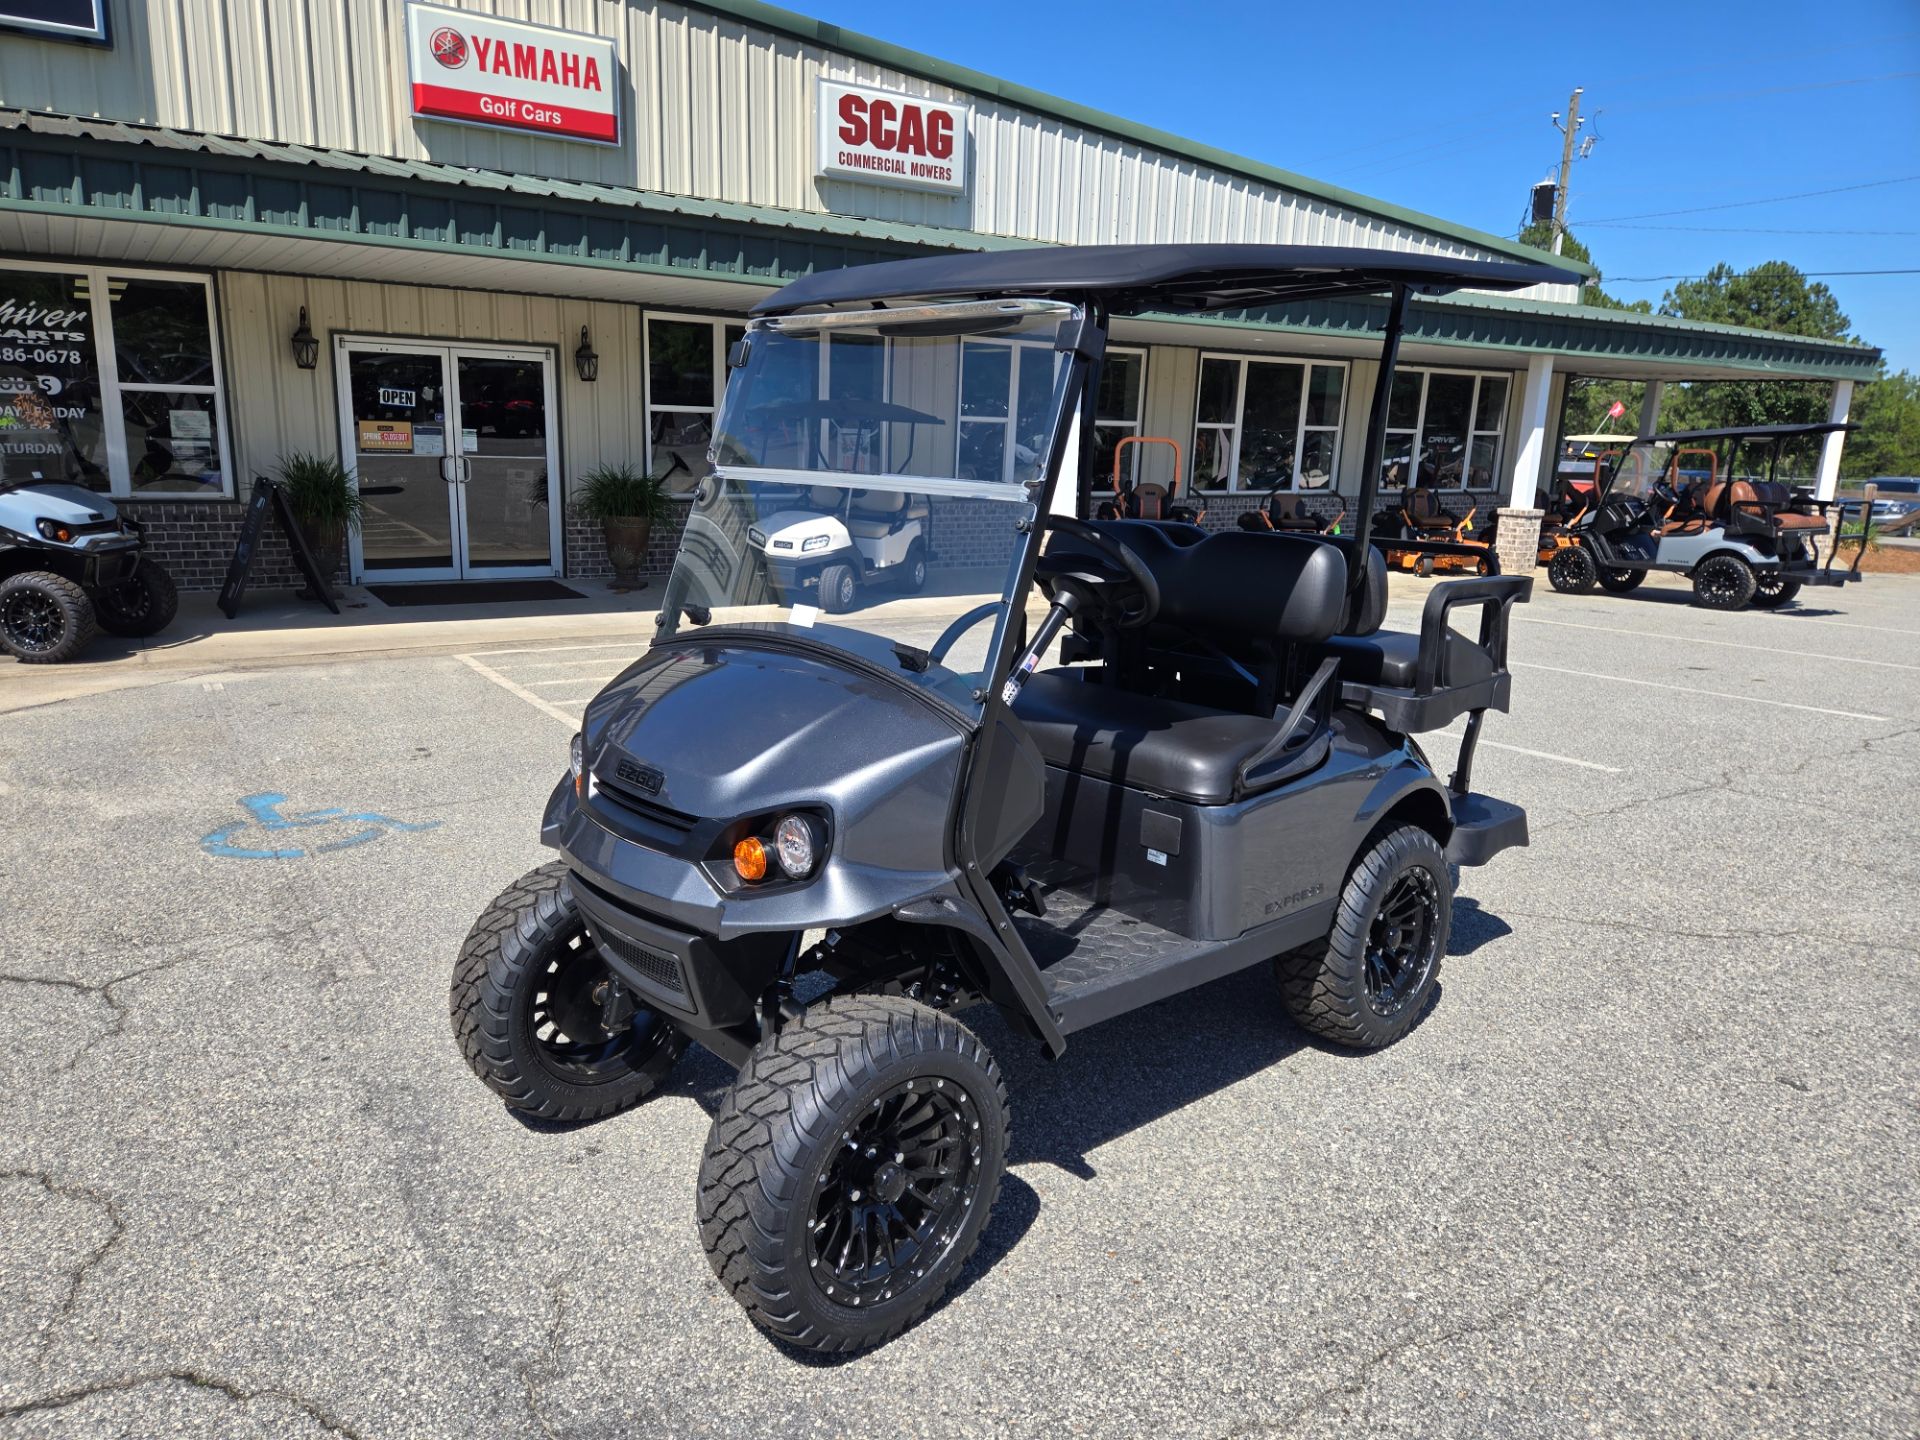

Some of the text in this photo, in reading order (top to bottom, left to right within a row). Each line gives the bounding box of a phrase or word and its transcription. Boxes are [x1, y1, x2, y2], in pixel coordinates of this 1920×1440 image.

[471, 35, 602, 92] YAMAHA
[480, 97, 562, 125] Golf Cars
[838, 93, 954, 160] SCAG
[838, 151, 952, 181] COMMERCIAL MOWERS
[0, 328, 86, 342] ARTS
[0, 347, 82, 365] 86-0678
[382, 389, 414, 406] OPEN
